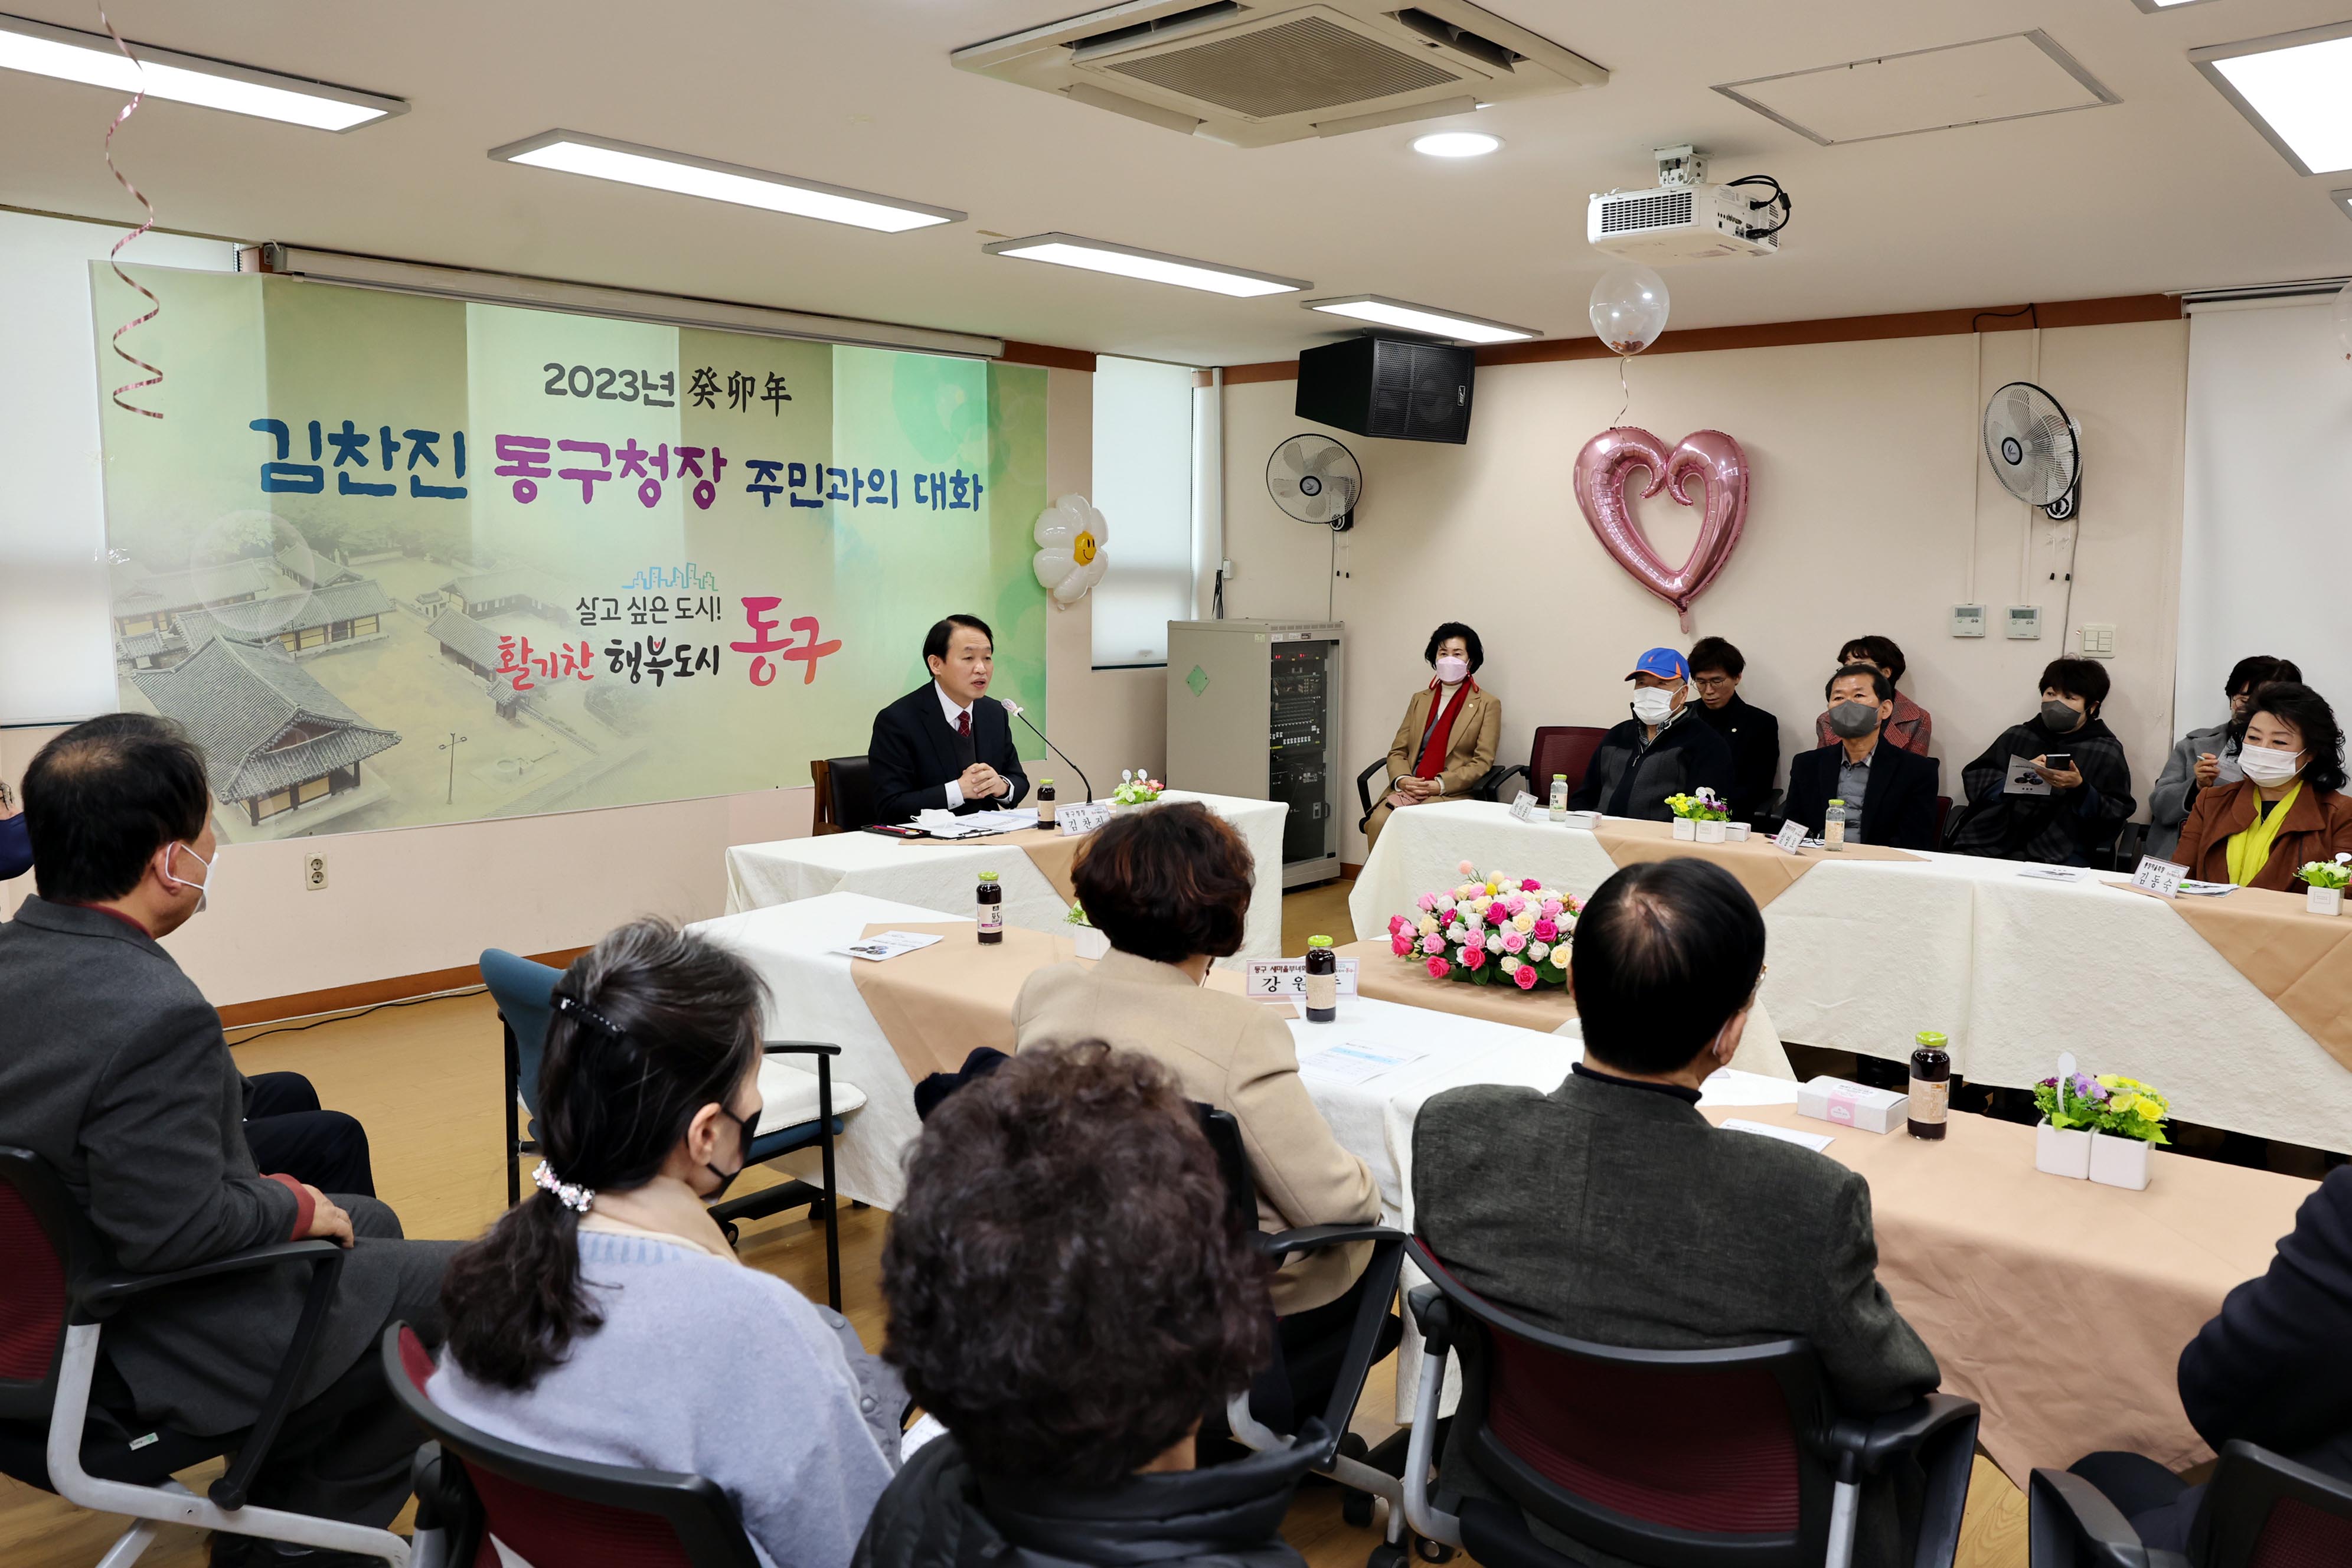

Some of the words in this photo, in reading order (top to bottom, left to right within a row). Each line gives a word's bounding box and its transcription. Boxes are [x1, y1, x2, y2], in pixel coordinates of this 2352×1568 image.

[543, 362, 675, 407] 2023년
[687, 366, 792, 417] 癸卯年
[249, 418, 468, 499] 김찬진
[494, 434, 727, 509] 동구청장
[746, 460, 897, 508] 주민과의
[914, 469, 984, 512] 대화
[576, 597, 622, 626] 살고
[627, 596, 669, 625] 싶은
[675, 596, 721, 622] 도시!
[495, 636, 594, 691] 활기찬
[605, 635, 719, 687] 행복도시
[730, 597, 842, 687] 동구
